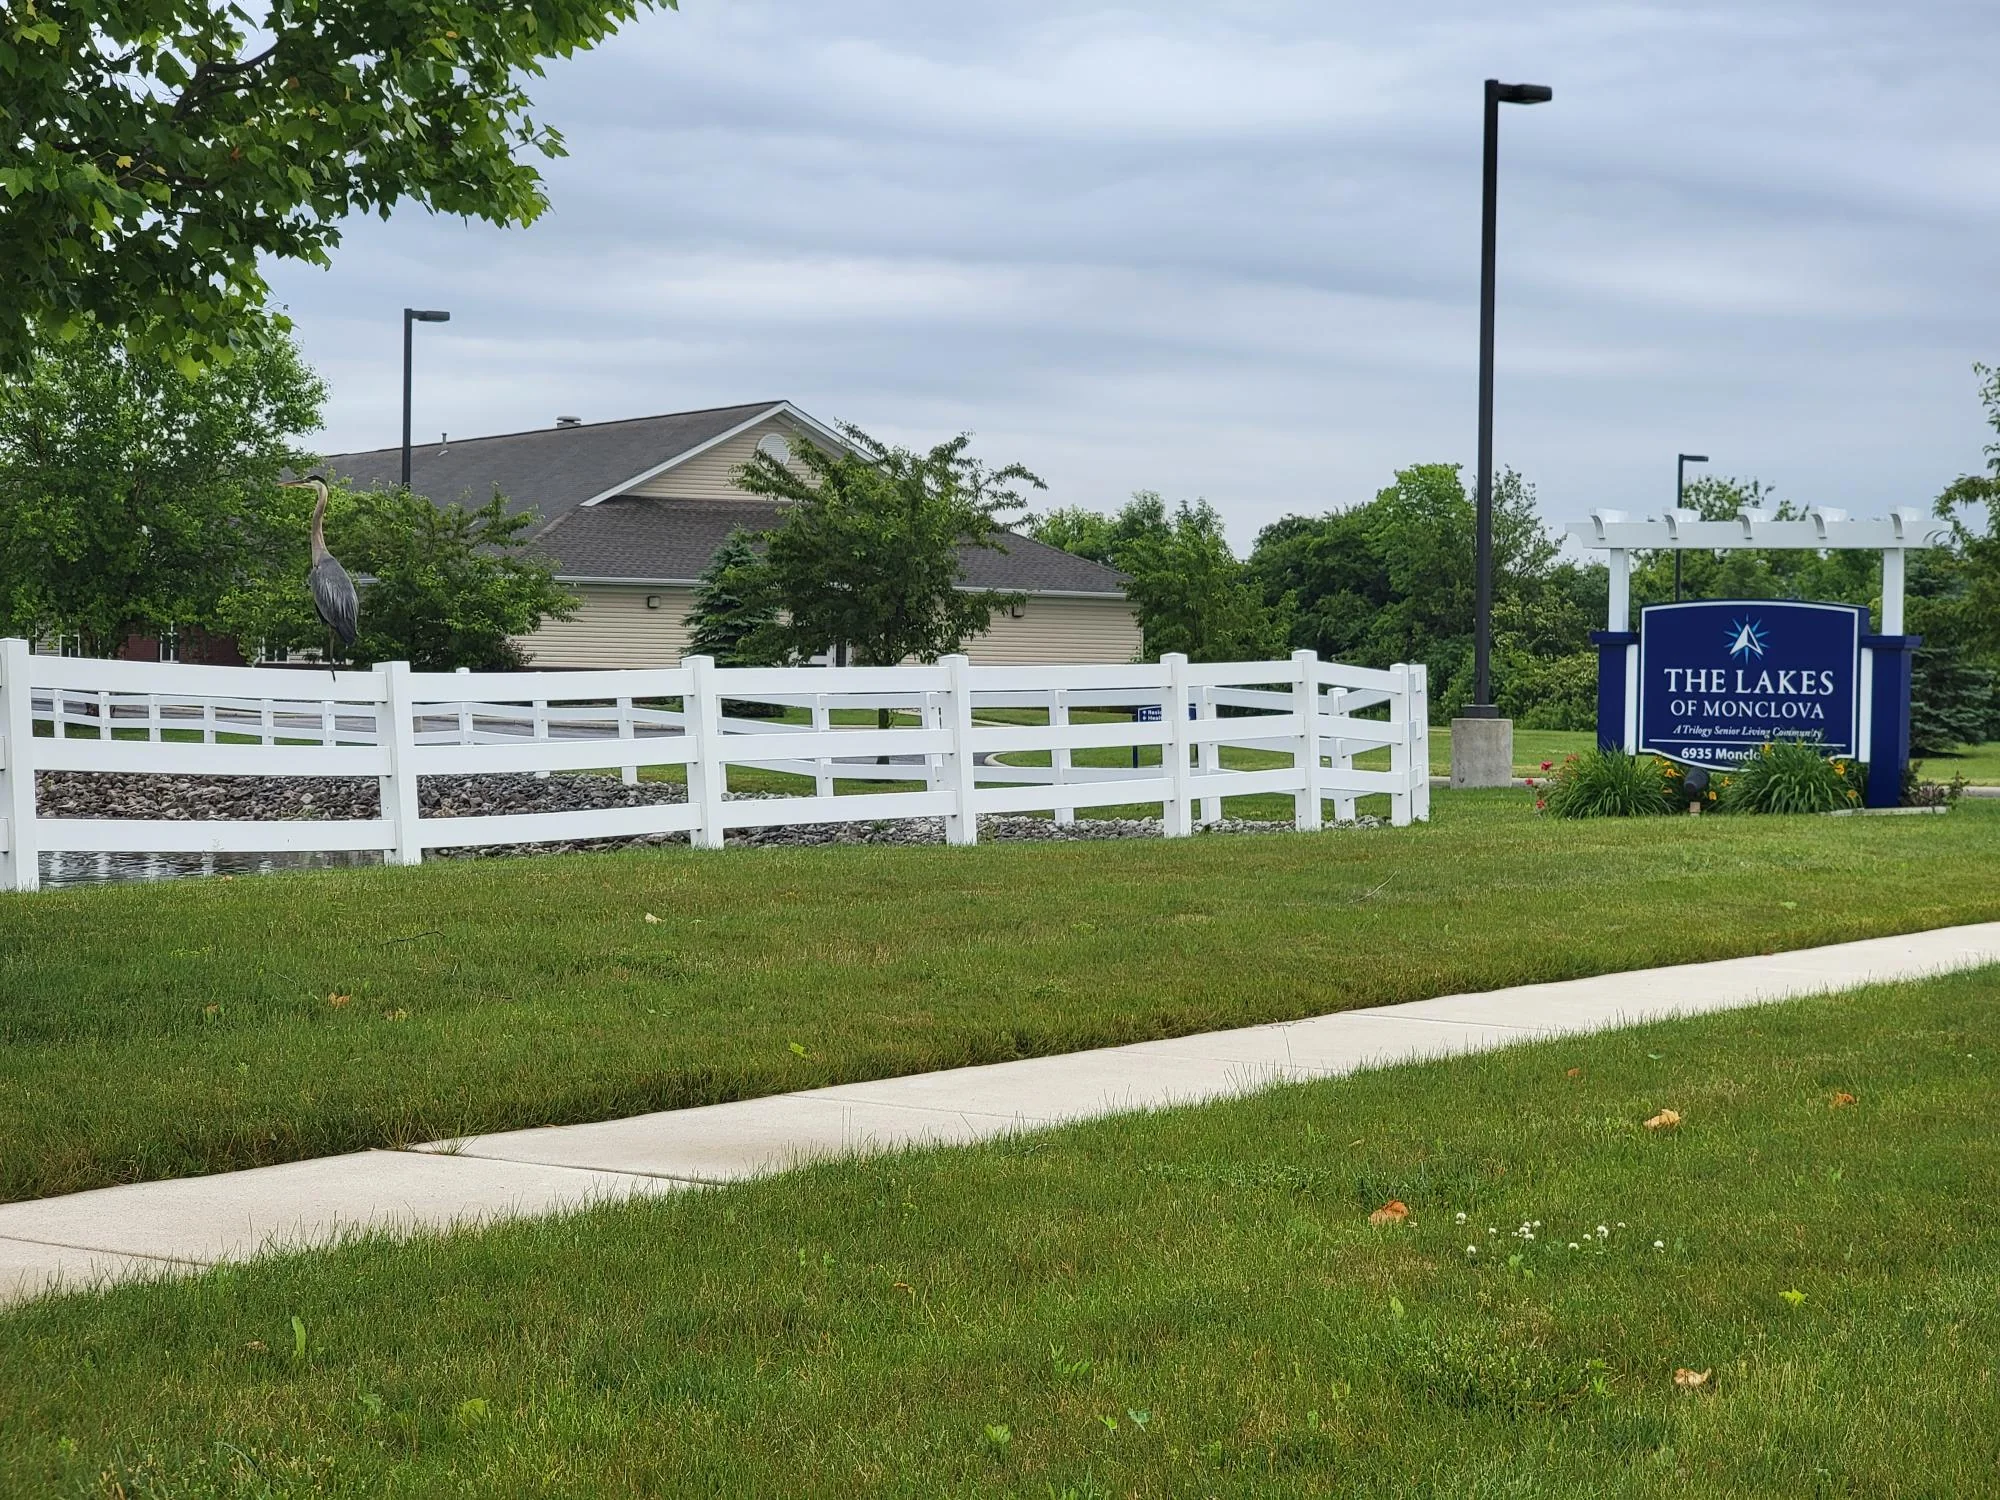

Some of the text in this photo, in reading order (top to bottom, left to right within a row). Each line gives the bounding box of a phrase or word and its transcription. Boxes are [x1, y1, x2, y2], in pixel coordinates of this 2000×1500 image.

[1664, 668, 1834, 696] THE LAKES
[1670, 700, 1825, 720] OF MONCLOVA
[1673, 725, 1682, 734] A
[1682, 725, 1712, 738] Trilogy
[1713, 726, 1740, 736] Senior
[1742, 726, 1770, 738] Living
[1681, 747, 1761, 761] 6935 Monclo
